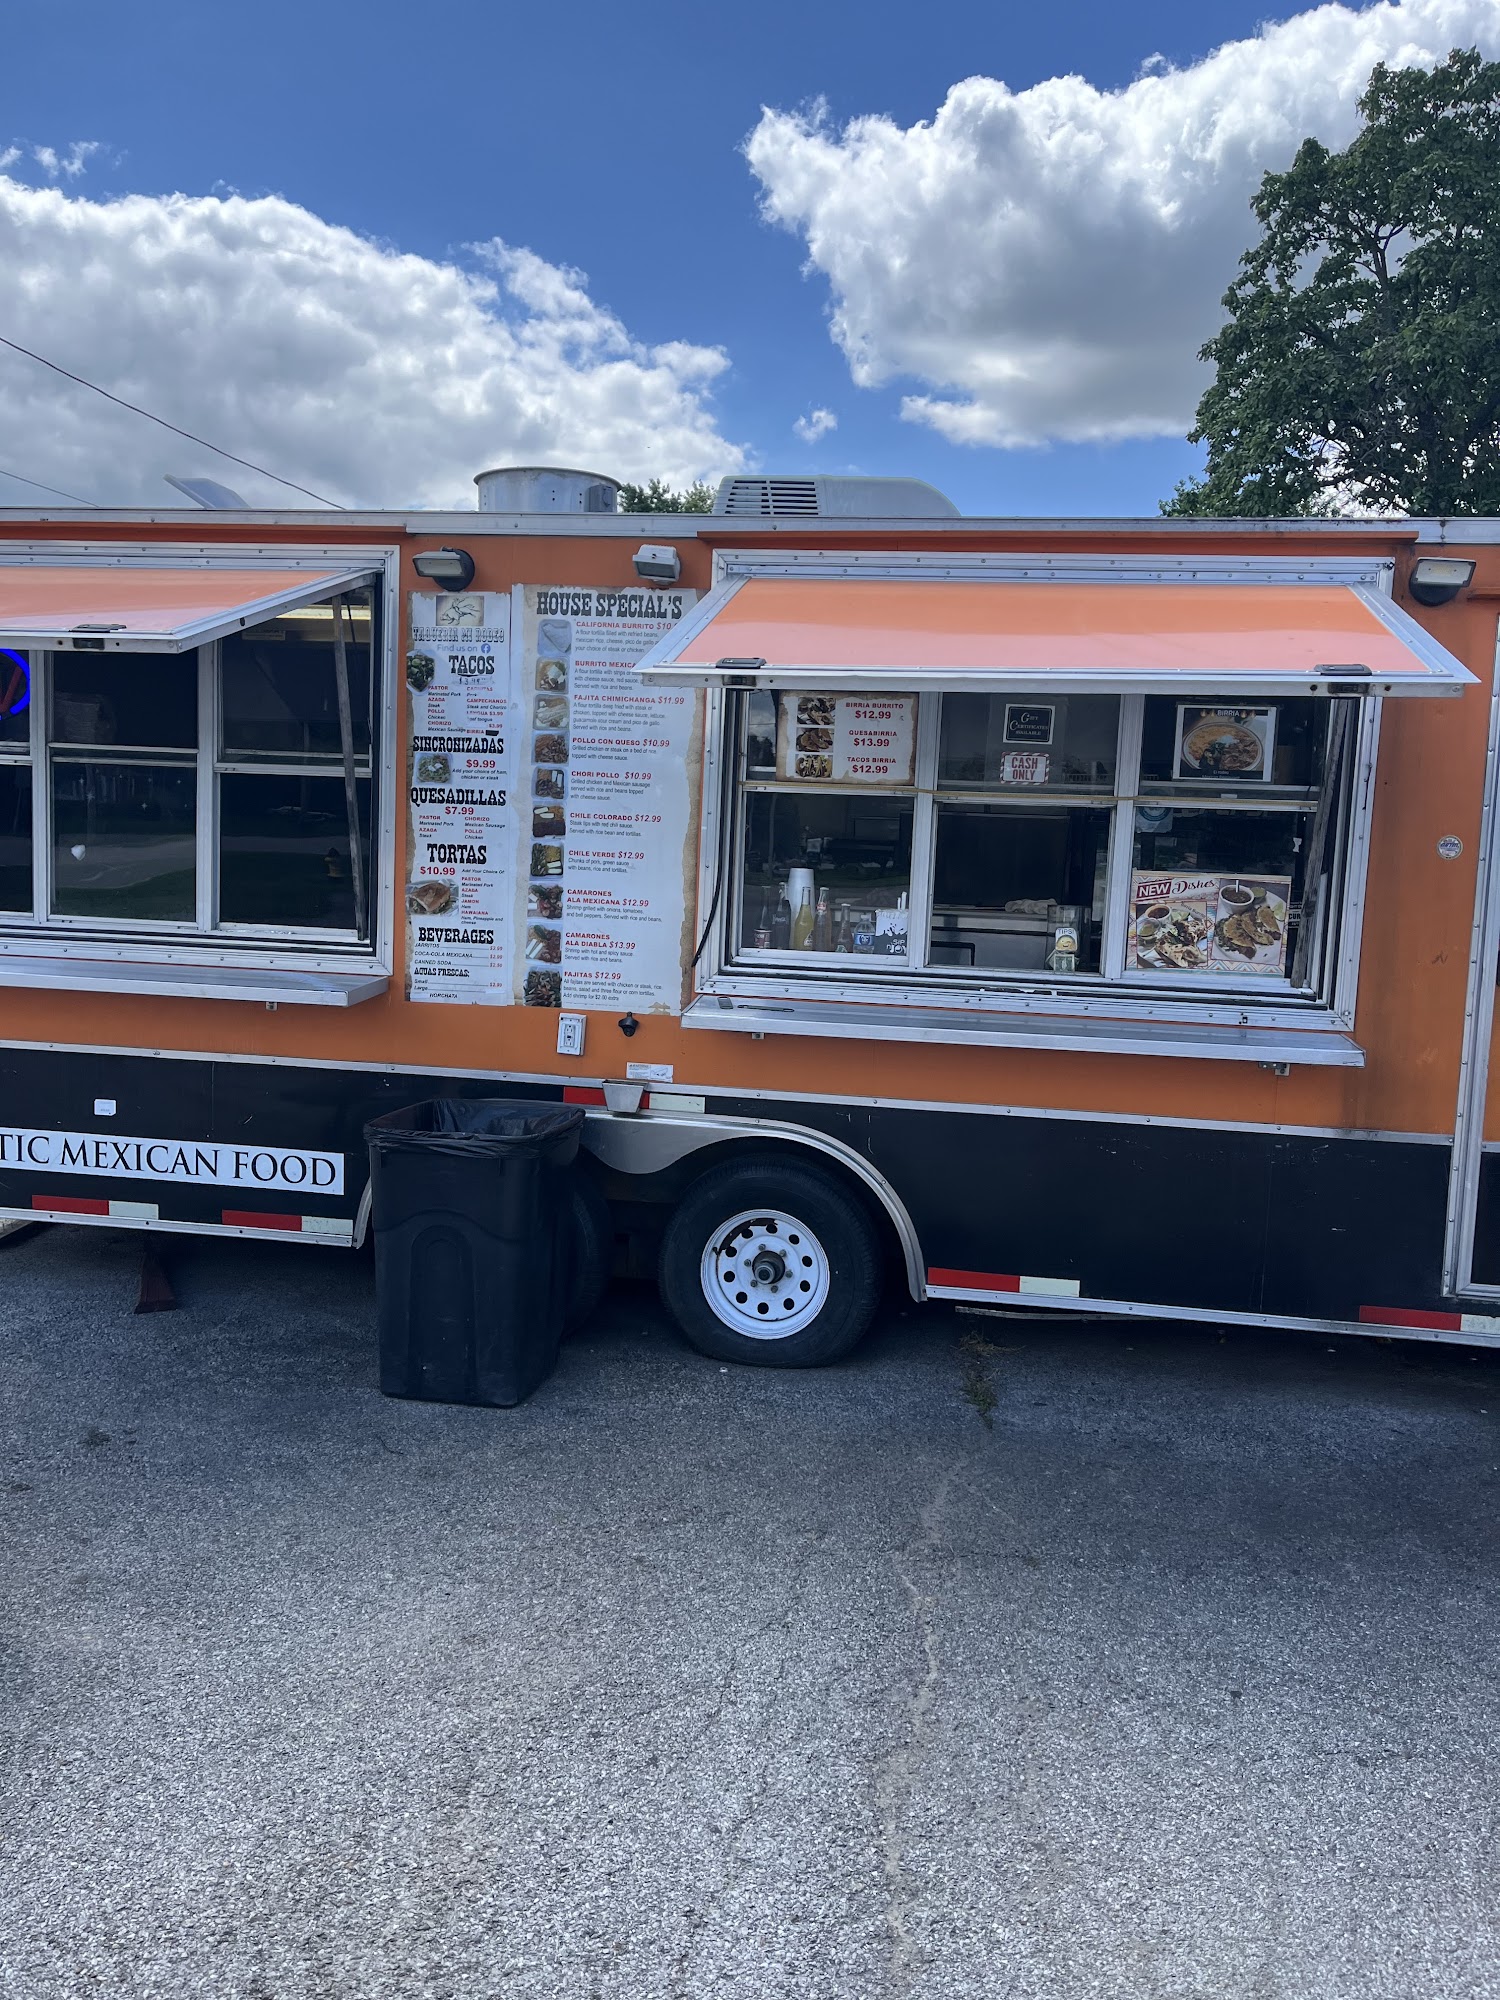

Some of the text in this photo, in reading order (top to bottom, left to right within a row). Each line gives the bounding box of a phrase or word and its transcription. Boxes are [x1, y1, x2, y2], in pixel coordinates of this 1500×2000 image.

[536, 592, 682, 620] HOUSE SPECIAL'S
[475, 628, 505, 643] RODEO
[449, 655, 495, 674] TACOS
[602, 695, 655, 703] CHIMICHANGA
[658, 696, 684, 704] $11.99
[855, 710, 891, 719] $12.99
[413, 736, 504, 754] SINCRONIZADAS
[643, 739, 670, 747] $10.99
[854, 738, 890, 747] $13.99
[466, 759, 496, 768] $9.99
[1011, 757, 1038, 769] CASH
[852, 765, 888, 773] $12.99
[625, 771, 652, 780] $10.99
[1012, 769, 1035, 780] ONLY
[410, 787, 506, 807] QUESADILLAS
[445, 806, 474, 815] $7.99
[634, 814, 661, 823] $12.99
[427, 843, 487, 865] TORTAS
[618, 851, 644, 859] $12.99
[420, 866, 456, 876] $10.99
[1139, 880, 1215, 897] NEW Dishes
[622, 898, 649, 907] $12.99
[419, 927, 494, 944] BEVERAGES
[565, 932, 610, 940] CAMARONES
[609, 941, 636, 949] $13.99
[414, 967, 437, 976] AGUAS
[595, 971, 621, 980] $12.99
[60, 1137, 221, 1178] MEXICAN
[233, 1151, 337, 1187] FOOD
